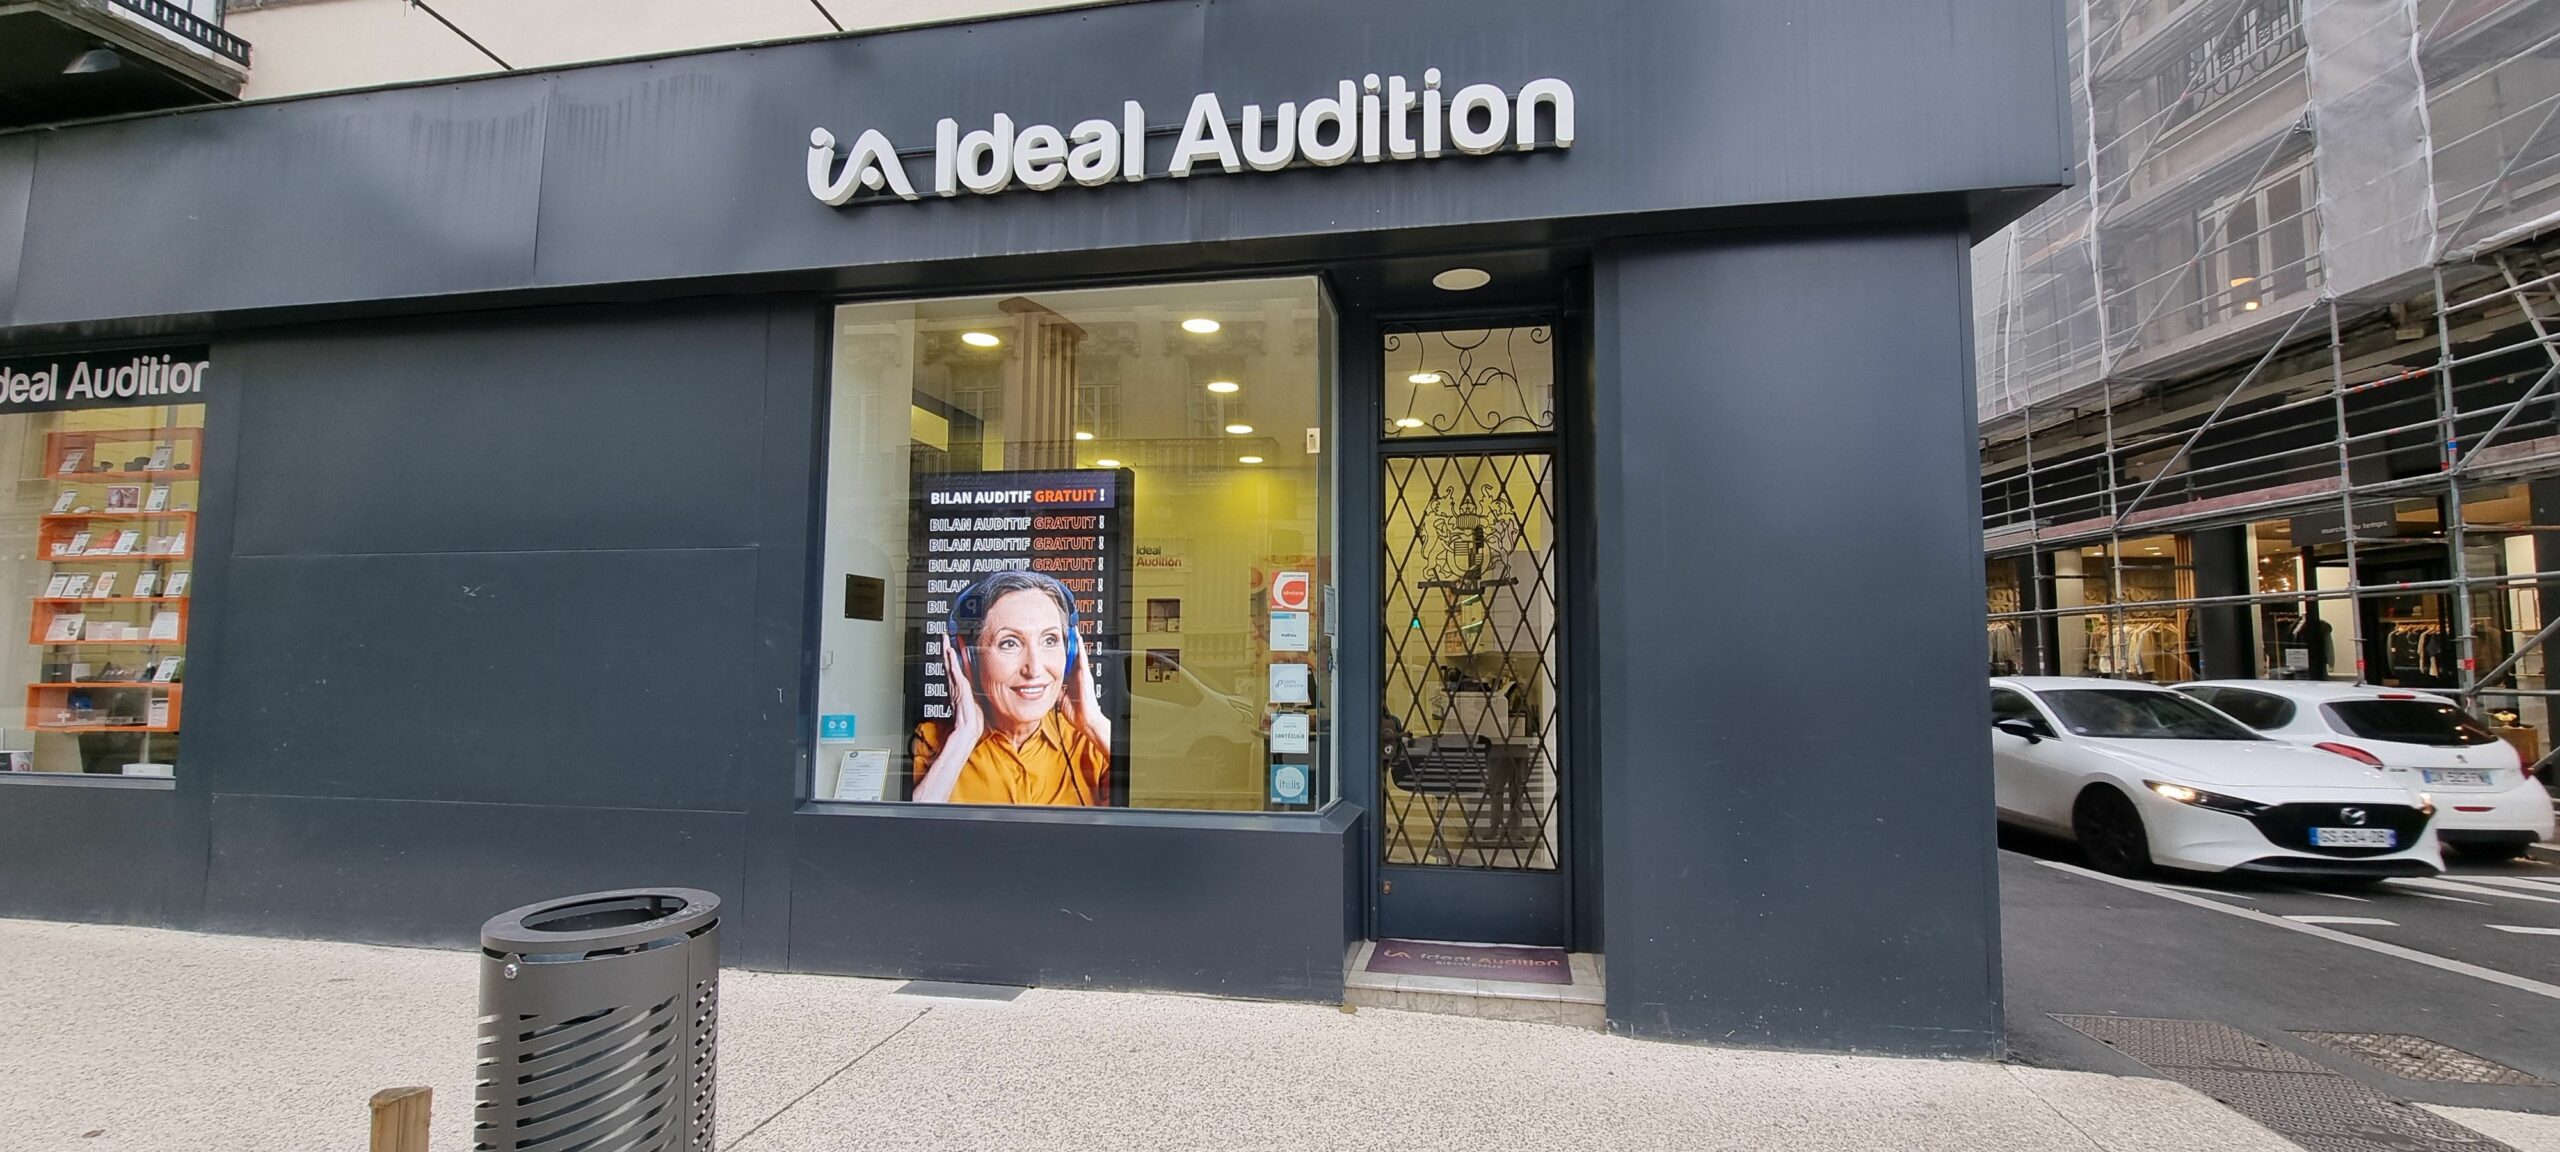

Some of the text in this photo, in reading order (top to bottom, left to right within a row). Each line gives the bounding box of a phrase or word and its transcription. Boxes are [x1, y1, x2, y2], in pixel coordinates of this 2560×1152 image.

[935, 99, 1145, 198] Ideal
[1169, 67, 1575, 178] Audition
[931, 489, 1105, 504] BILAN AUDITIF GRATUIT !
[930, 515, 1105, 531] BILAN AUDITIF GRATUIT !
[929, 536, 1104, 551] BILAN AUDITIF GRATUIT !
[1136, 545, 1161, 556] Ideal
[928, 557, 1104, 572] BILAN AUDITIF GRATUIT !
[1136, 556, 1182, 567] Audition
[1420, 953, 1471, 962] Ideal
[1477, 957, 1559, 967] Audition
